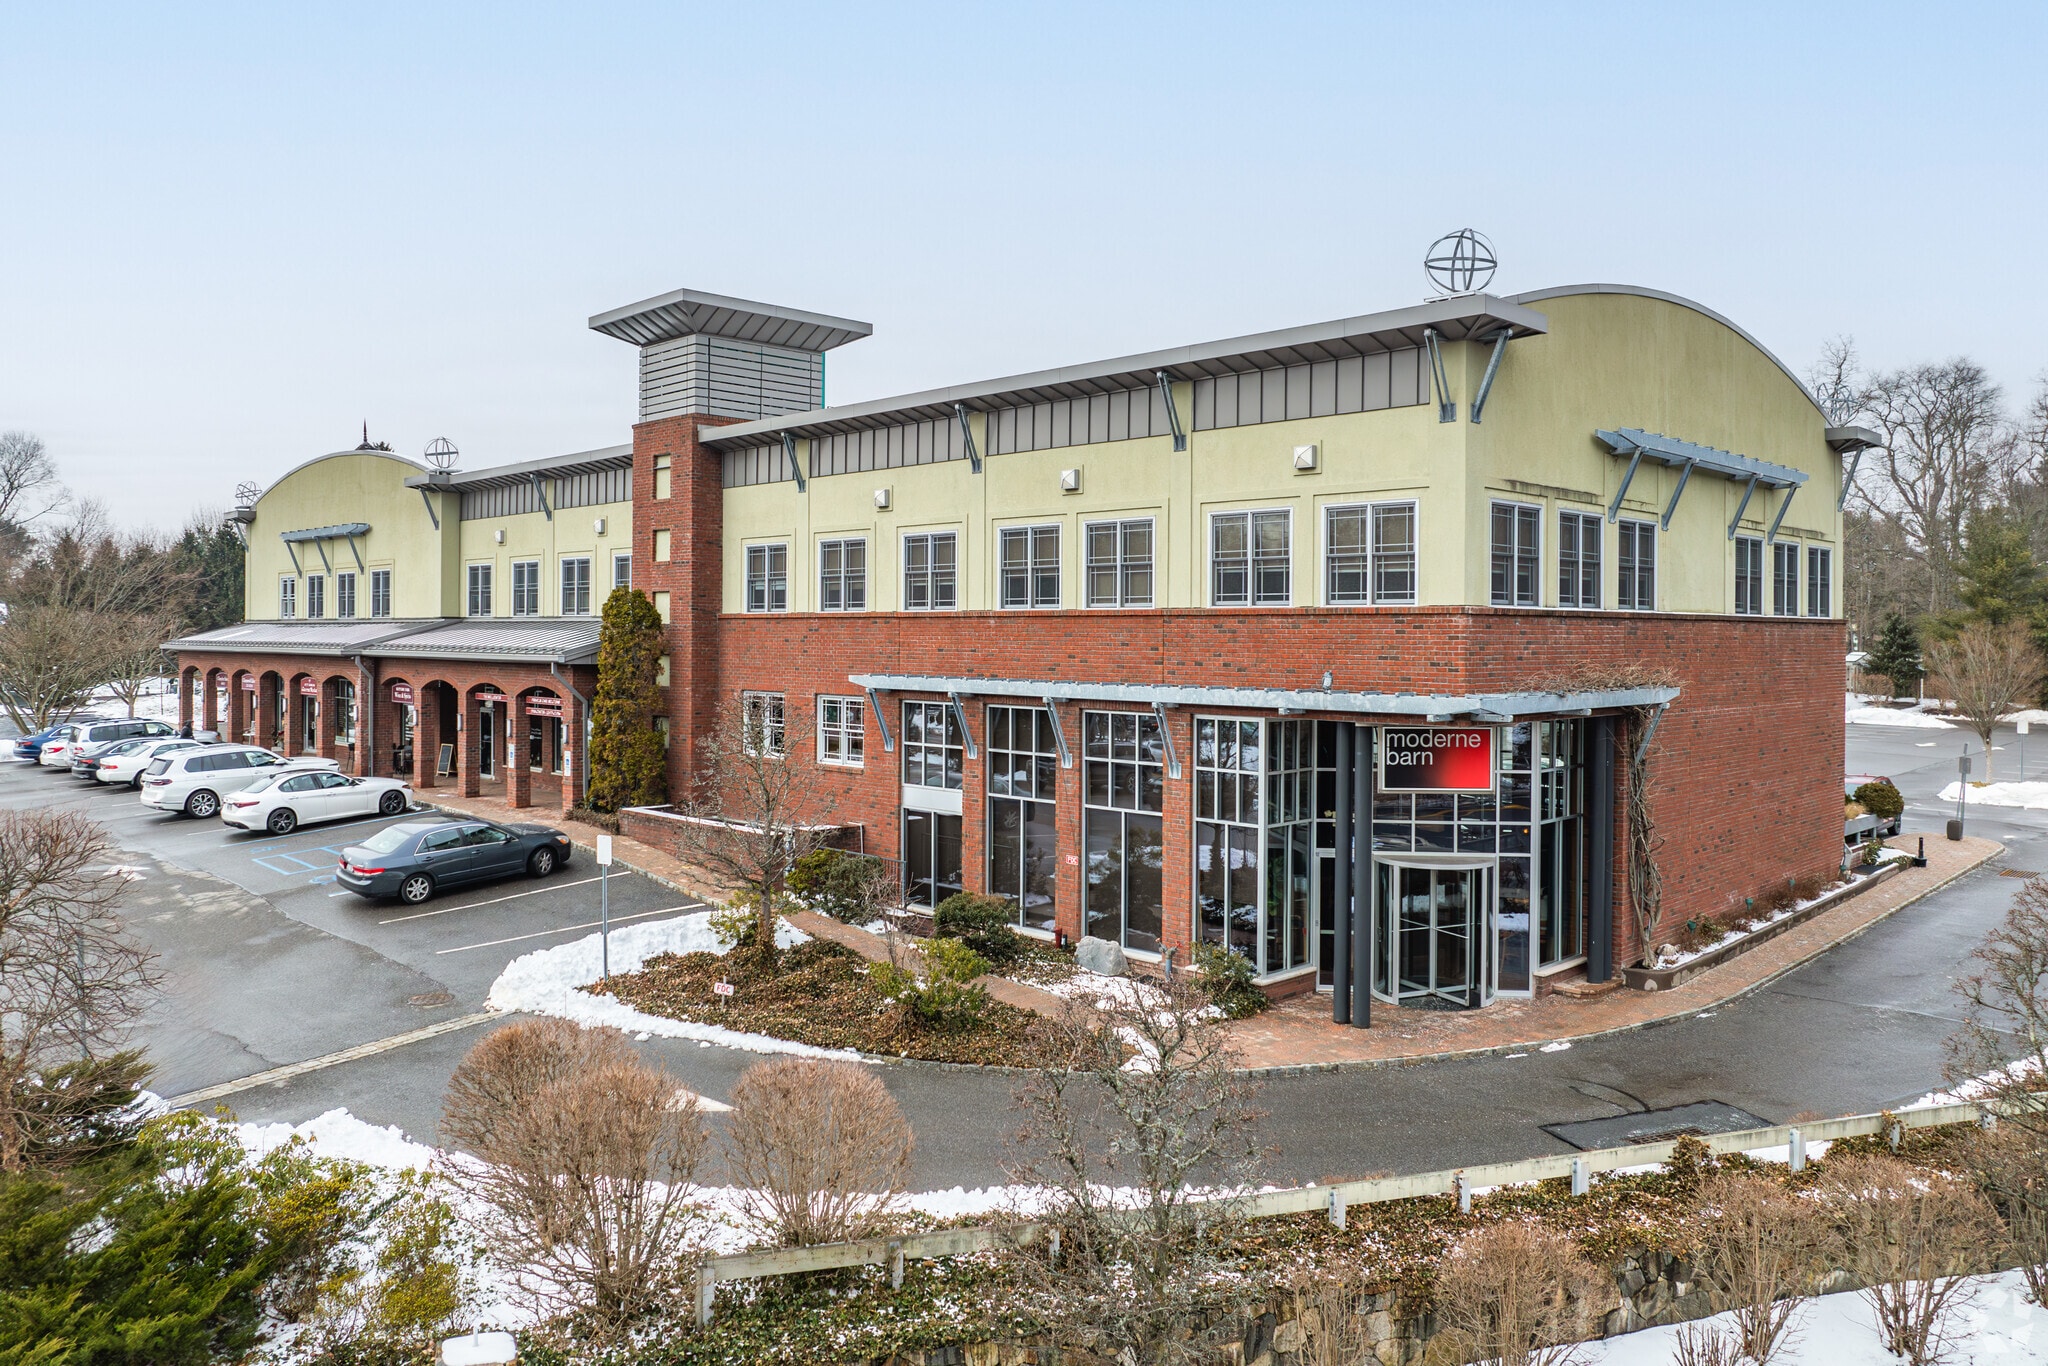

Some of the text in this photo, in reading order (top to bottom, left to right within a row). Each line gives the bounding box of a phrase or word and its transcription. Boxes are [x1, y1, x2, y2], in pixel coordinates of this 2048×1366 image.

[1386, 729, 1482, 748] moderne
[1386, 746, 1433, 766] barn
[716, 984, 731, 993] FDC
